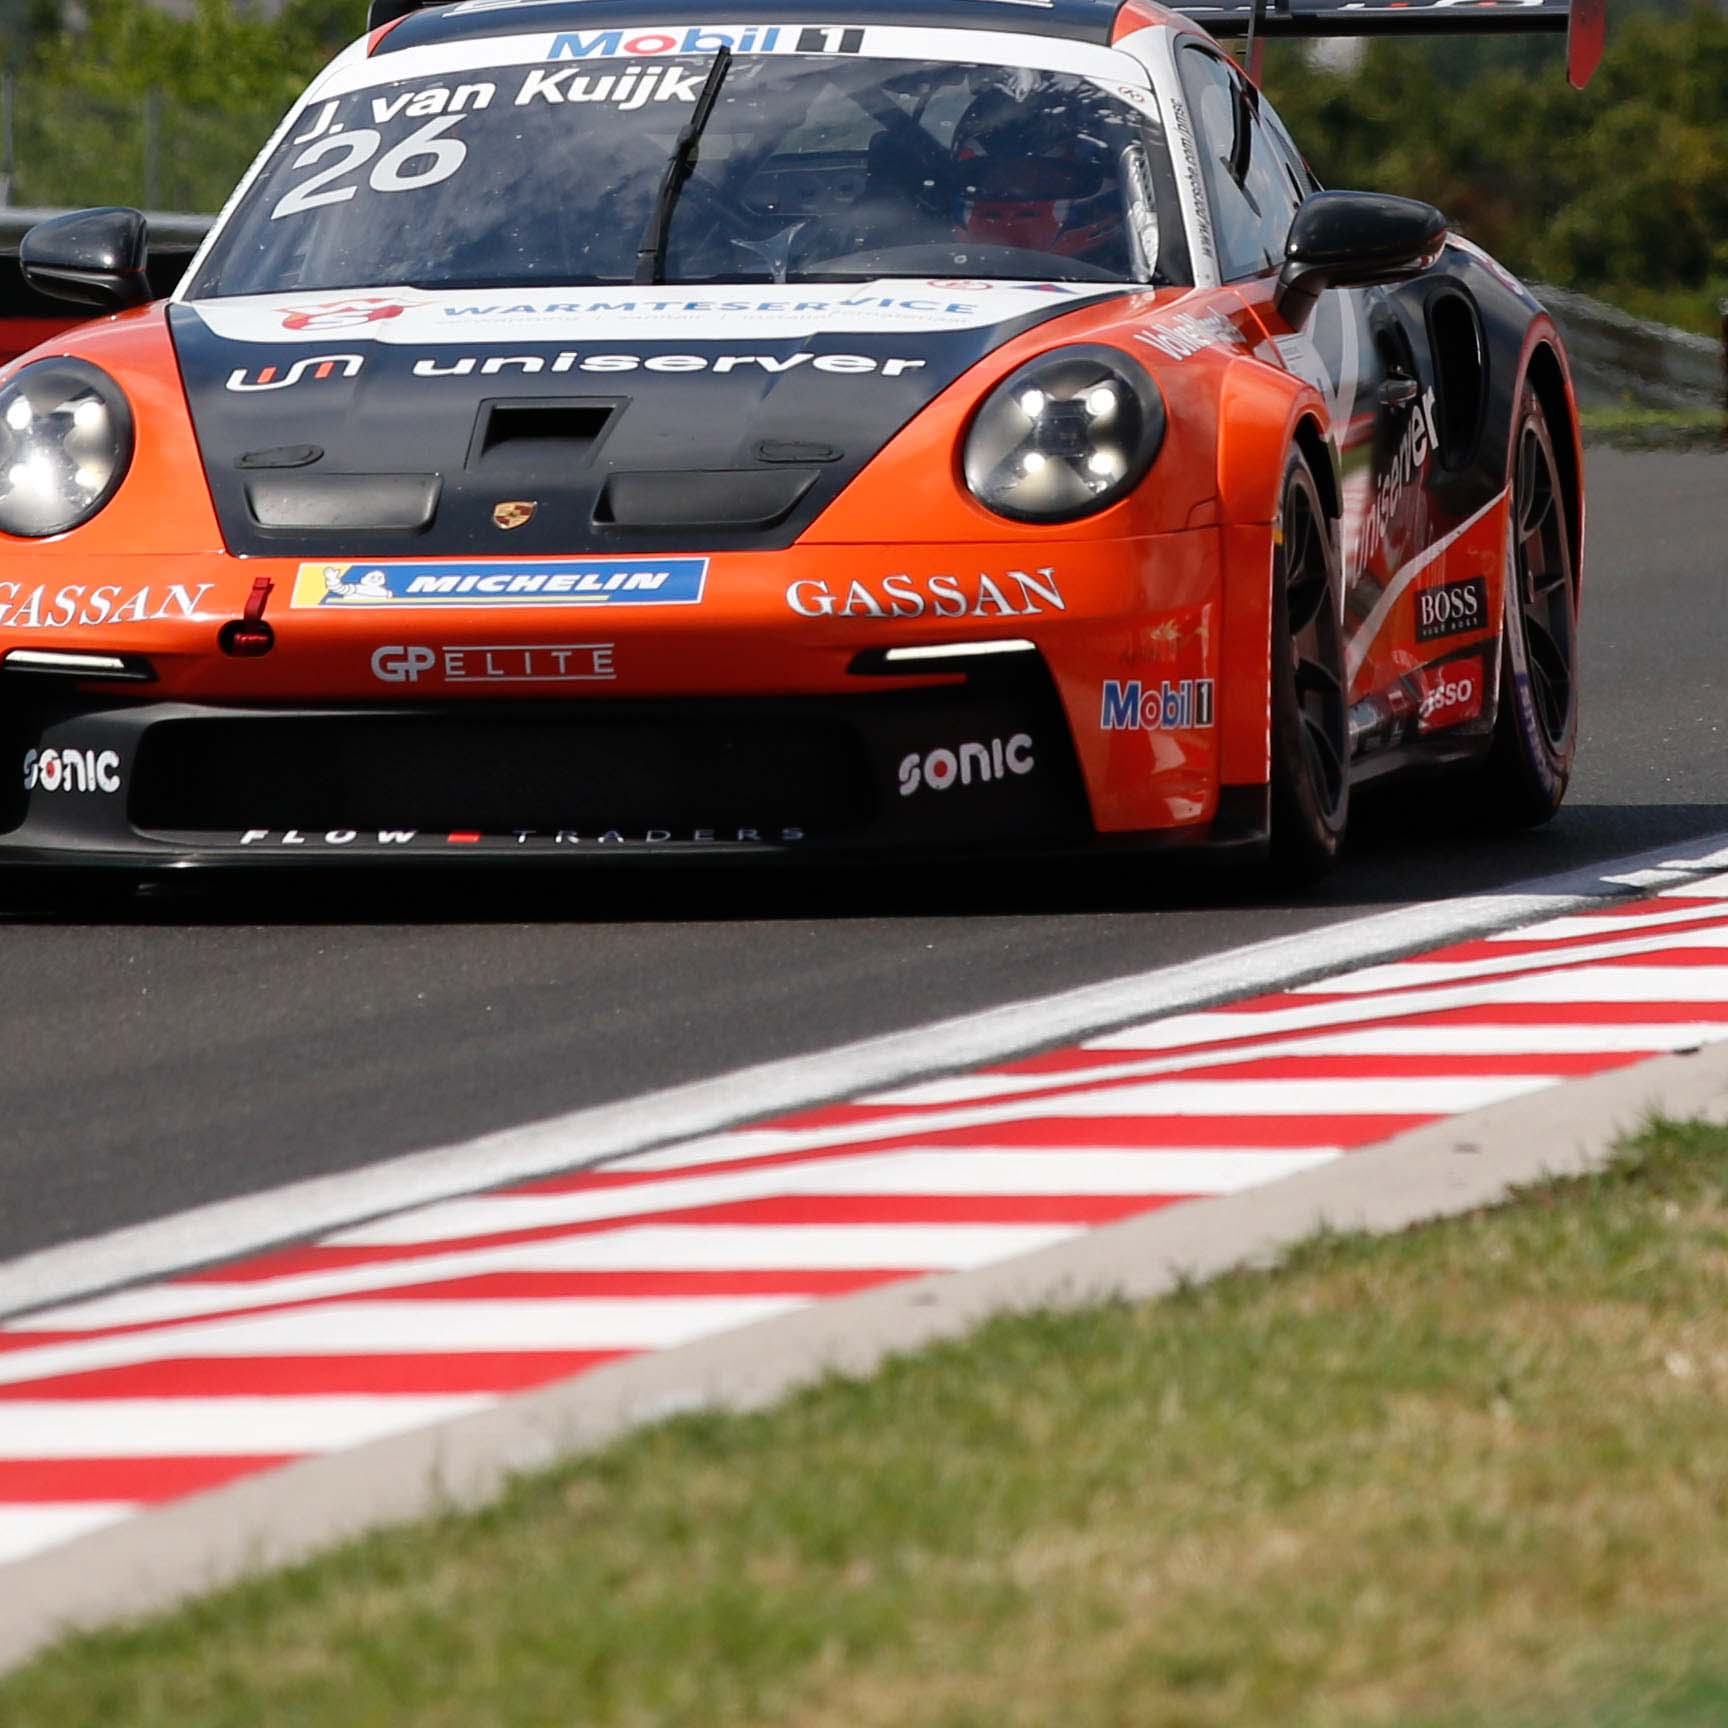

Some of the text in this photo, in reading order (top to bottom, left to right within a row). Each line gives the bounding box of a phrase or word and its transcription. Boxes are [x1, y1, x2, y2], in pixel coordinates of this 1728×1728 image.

[547, 28, 780, 59] Mobil
[293, 66, 707, 145] J. van Kuijk
[270, 113, 468, 220] 26
[444, 297, 978, 318] WARMTESERVICE
[412, 352, 927, 378] uniserver
[406, 571, 670, 594] MICHELIN
[785, 567, 1066, 617] GASSAN
[1421, 585, 1478, 624] BOSS
[1100, 679, 1193, 730] Mobil
[240, 827, 805, 845] FLOW TRADERS
